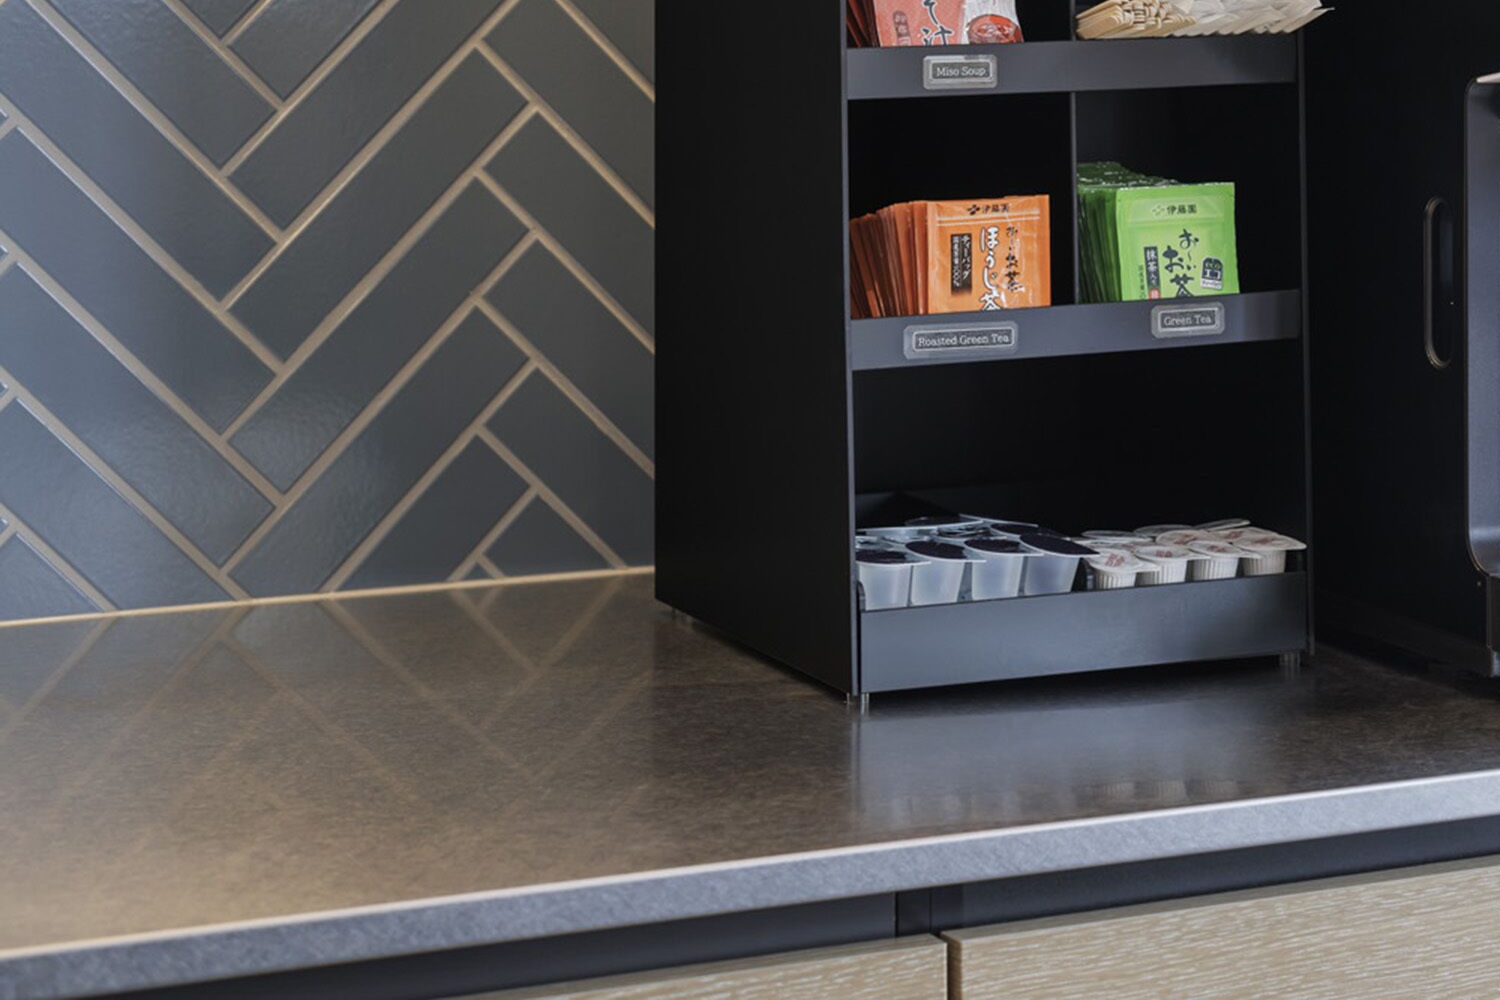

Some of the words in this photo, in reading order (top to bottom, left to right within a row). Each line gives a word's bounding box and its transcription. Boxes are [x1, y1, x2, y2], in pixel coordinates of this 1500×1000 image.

[936, 66, 960, 77] Miso
[961, 66, 986, 77] Soup
[1166, 203, 1198, 215] 伊藤園
[1163, 316, 1193, 327] Green
[1194, 314, 1212, 324] Tea
[918, 335, 957, 347] Roasted
[959, 334, 989, 345] Green
[991, 333, 1010, 343] Tea
